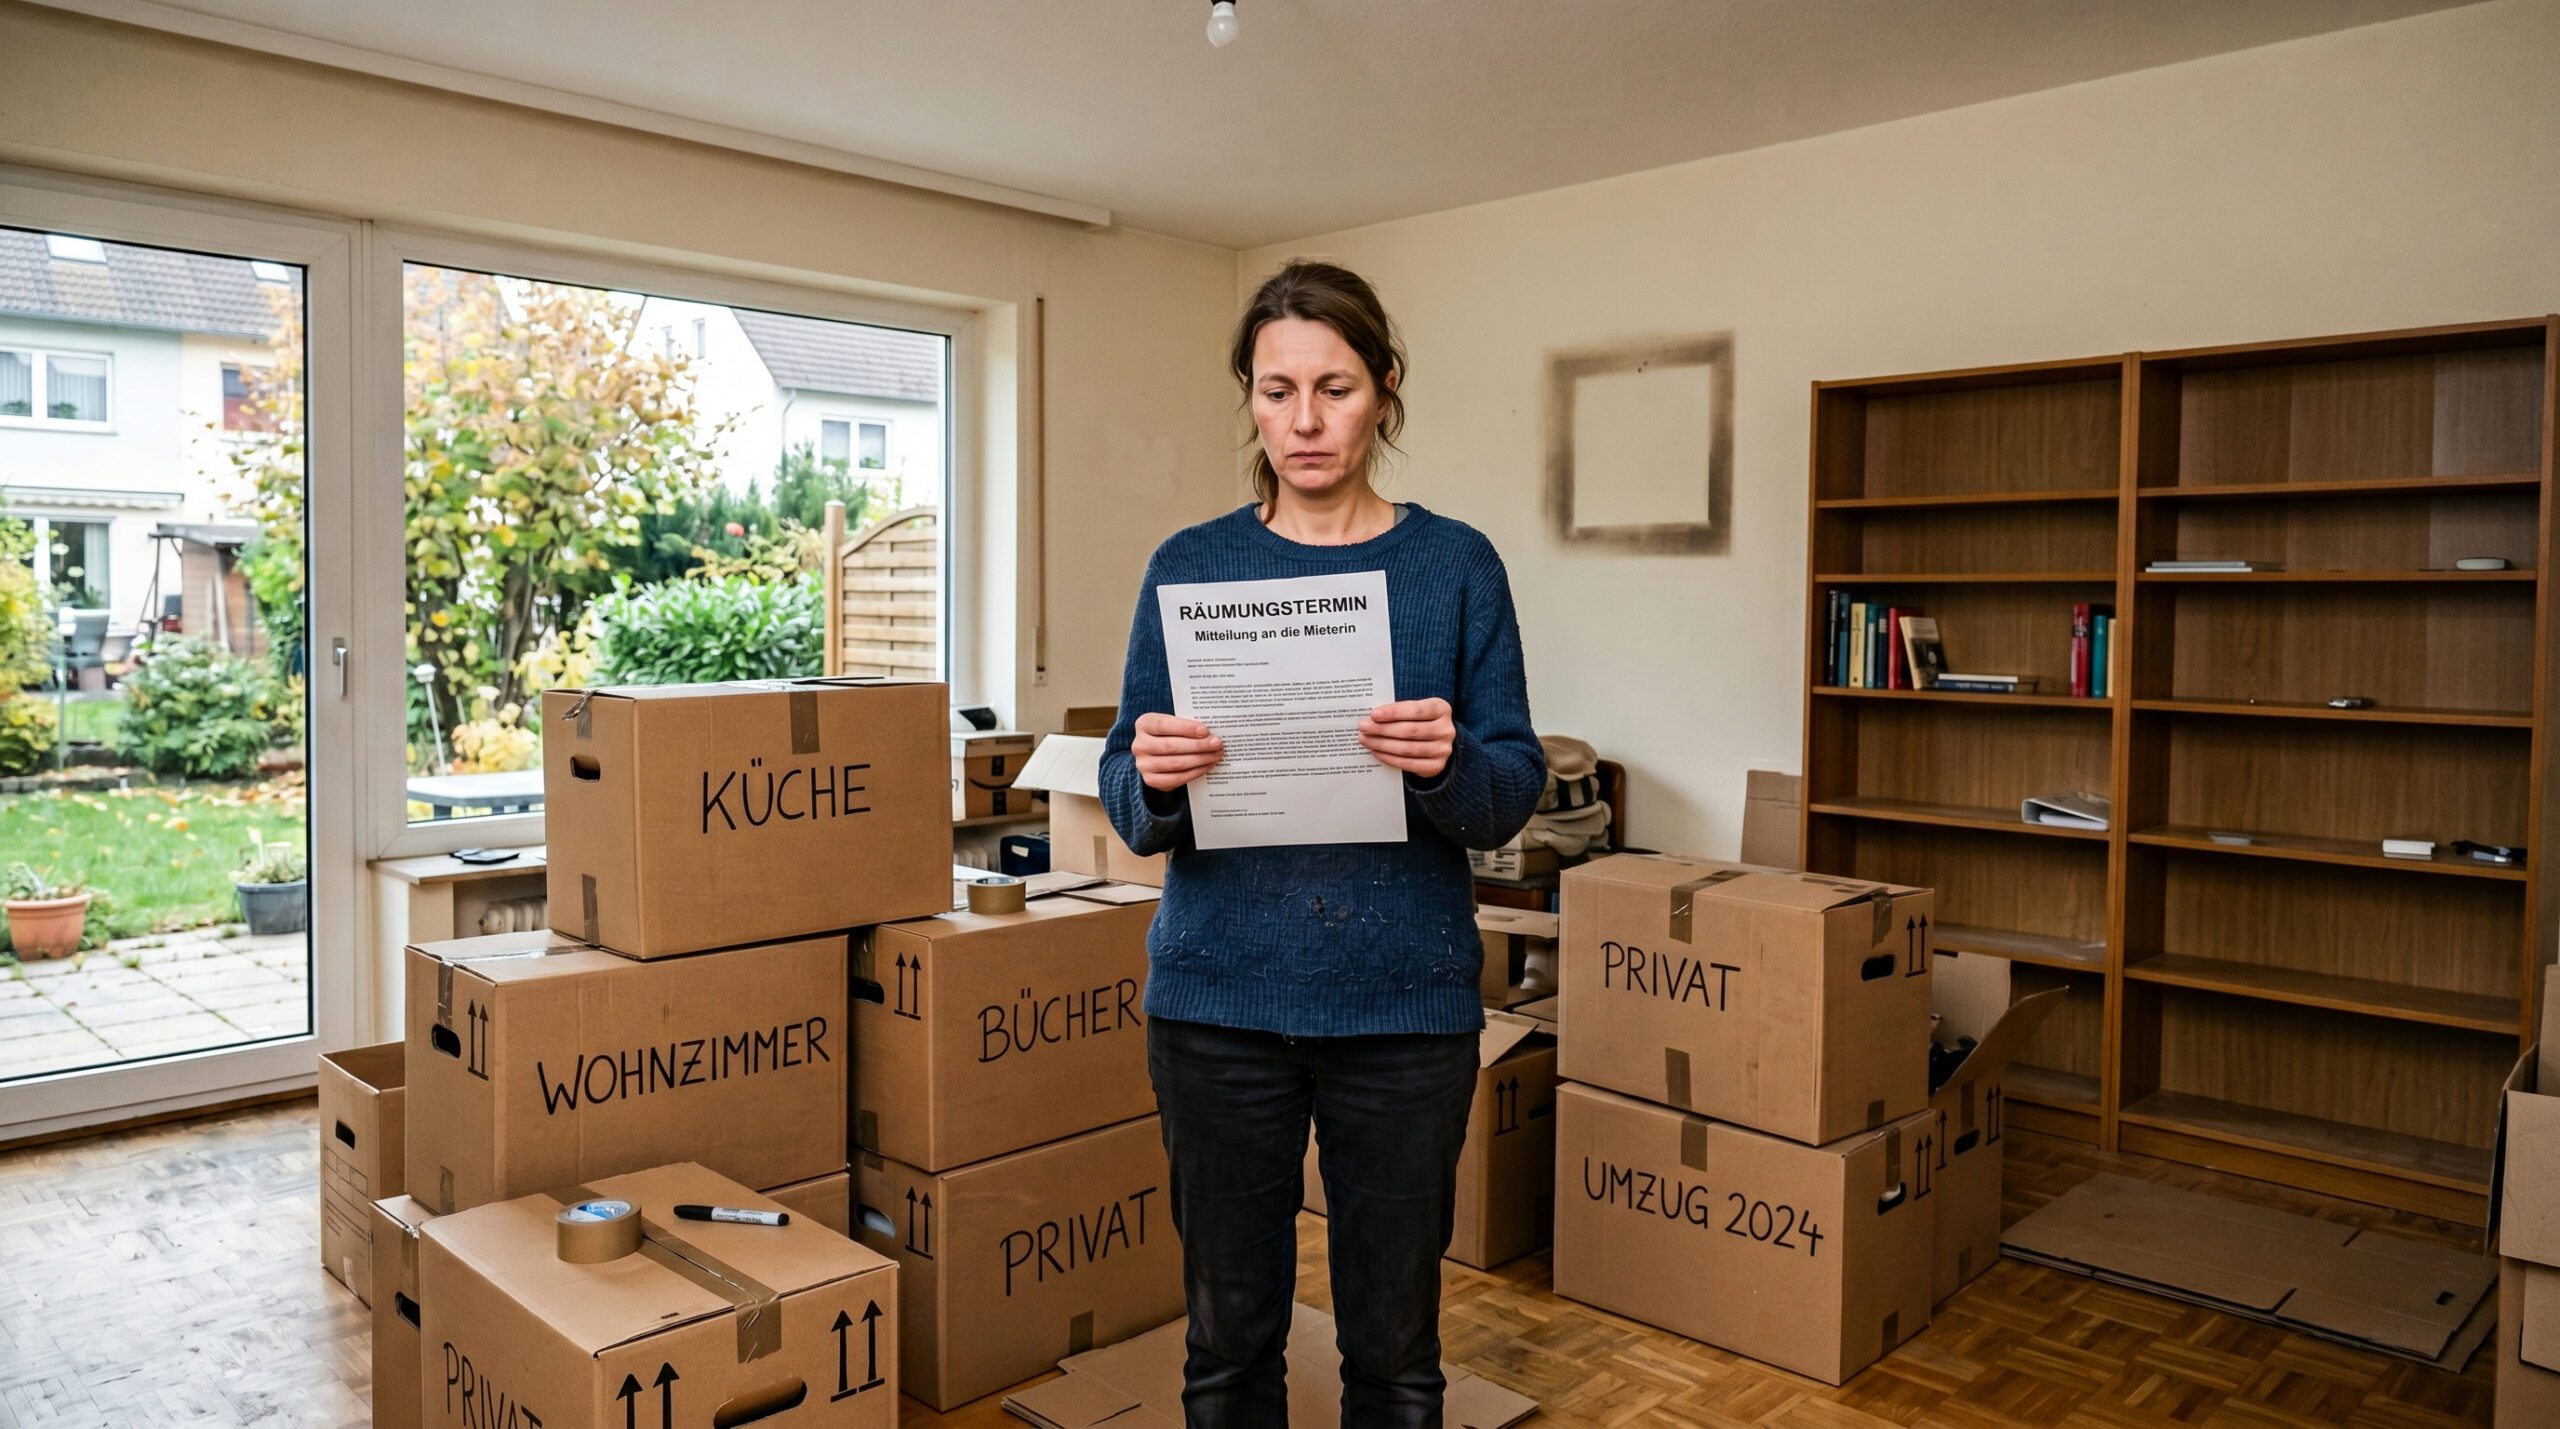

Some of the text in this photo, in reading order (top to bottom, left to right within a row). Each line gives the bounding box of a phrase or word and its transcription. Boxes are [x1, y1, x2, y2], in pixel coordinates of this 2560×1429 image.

[1179, 595, 1368, 621] RÄUMUNGSTERMIN
[1194, 623, 1356, 642] Mitteilung an die Mieterin
[702, 757, 872, 834] KÜCHE
[1600, 940, 1741, 1012] PRIVAT
[977, 978, 1141, 1063] BÜCHER
[537, 1016, 831, 1116] WOHNZIMMER
[999, 1186, 1158, 1297] PRIVAT
[1584, 1156, 1824, 1257] UMZUG 2024
